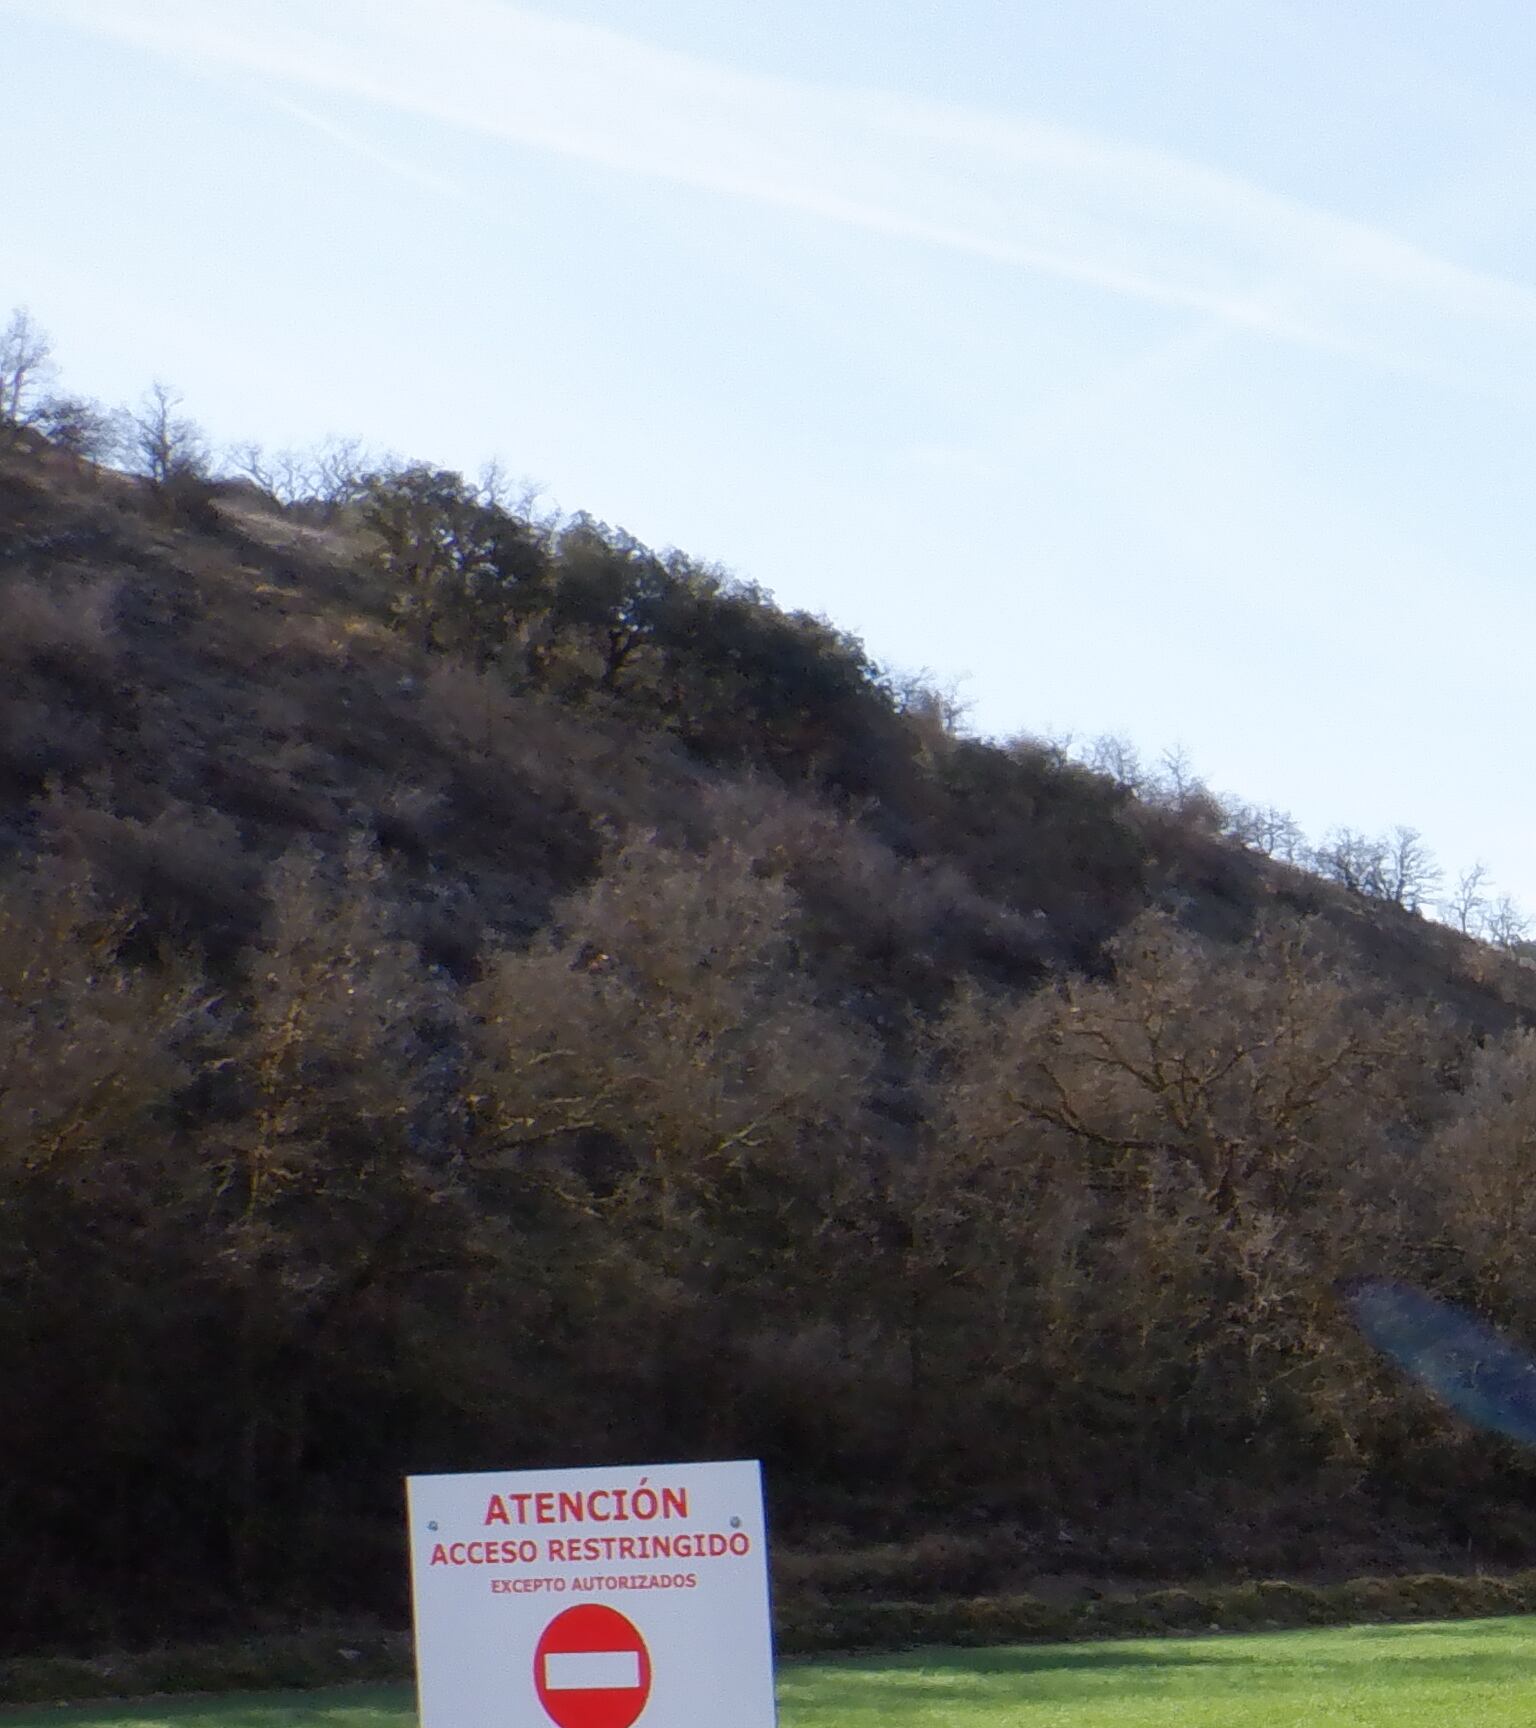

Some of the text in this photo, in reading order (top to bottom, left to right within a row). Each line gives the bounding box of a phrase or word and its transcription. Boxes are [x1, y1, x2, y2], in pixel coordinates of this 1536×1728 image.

[484, 1478, 688, 1525] ATENCIÓN
[430, 1532, 750, 1566] ACCESO RESTRINGIDO
[490, 1574, 696, 1593] EXCEPTO AUTORIZADOS
